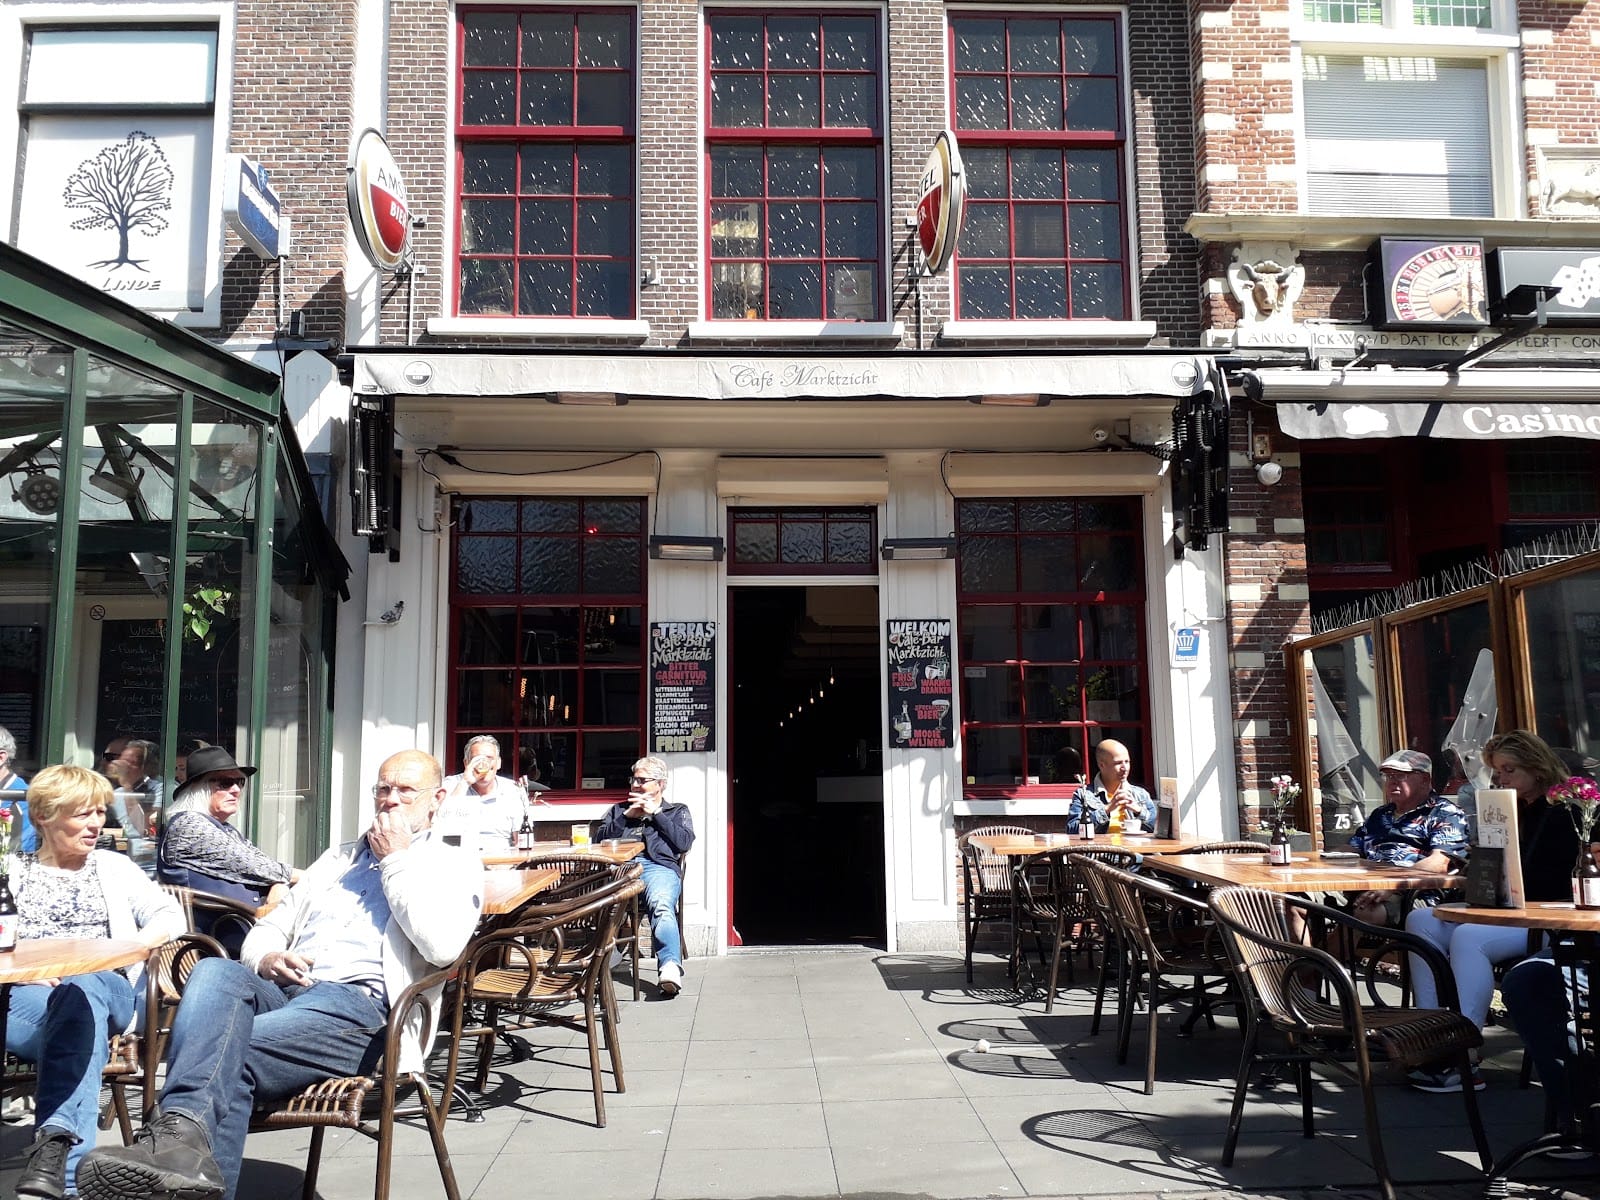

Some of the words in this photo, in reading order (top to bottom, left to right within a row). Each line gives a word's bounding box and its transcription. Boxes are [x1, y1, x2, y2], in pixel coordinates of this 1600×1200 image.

[1465, 246, 1472, 255] 17
[103, 278, 161, 292] LINDE
[1248, 333, 1297, 344] ANNO
[1314, 333, 1334, 344] ICK
[1400, 334, 1427, 345] DAT
[1438, 335, 1460, 346] ICK
[1516, 337, 1560, 348] PEERT
[730, 364, 773, 393] Café
[780, 364, 878, 388] Marktzicht
[658, 622, 715, 639] TERRAS
[890, 621, 950, 636] WELKOM
[652, 647, 712, 668] Marktzicht
[888, 645, 946, 665] Marktzicht
[669, 662, 698, 670] BITTER
[656, 671, 707, 680] GARNITUUR
[892, 672, 912, 682] FRIS
[921, 678, 951, 686] WARME
[917, 710, 938, 720] BIER
[914, 729, 941, 738] MOOIE
[656, 735, 694, 752] FRIET
[908, 738, 946, 747] WIJNEN
